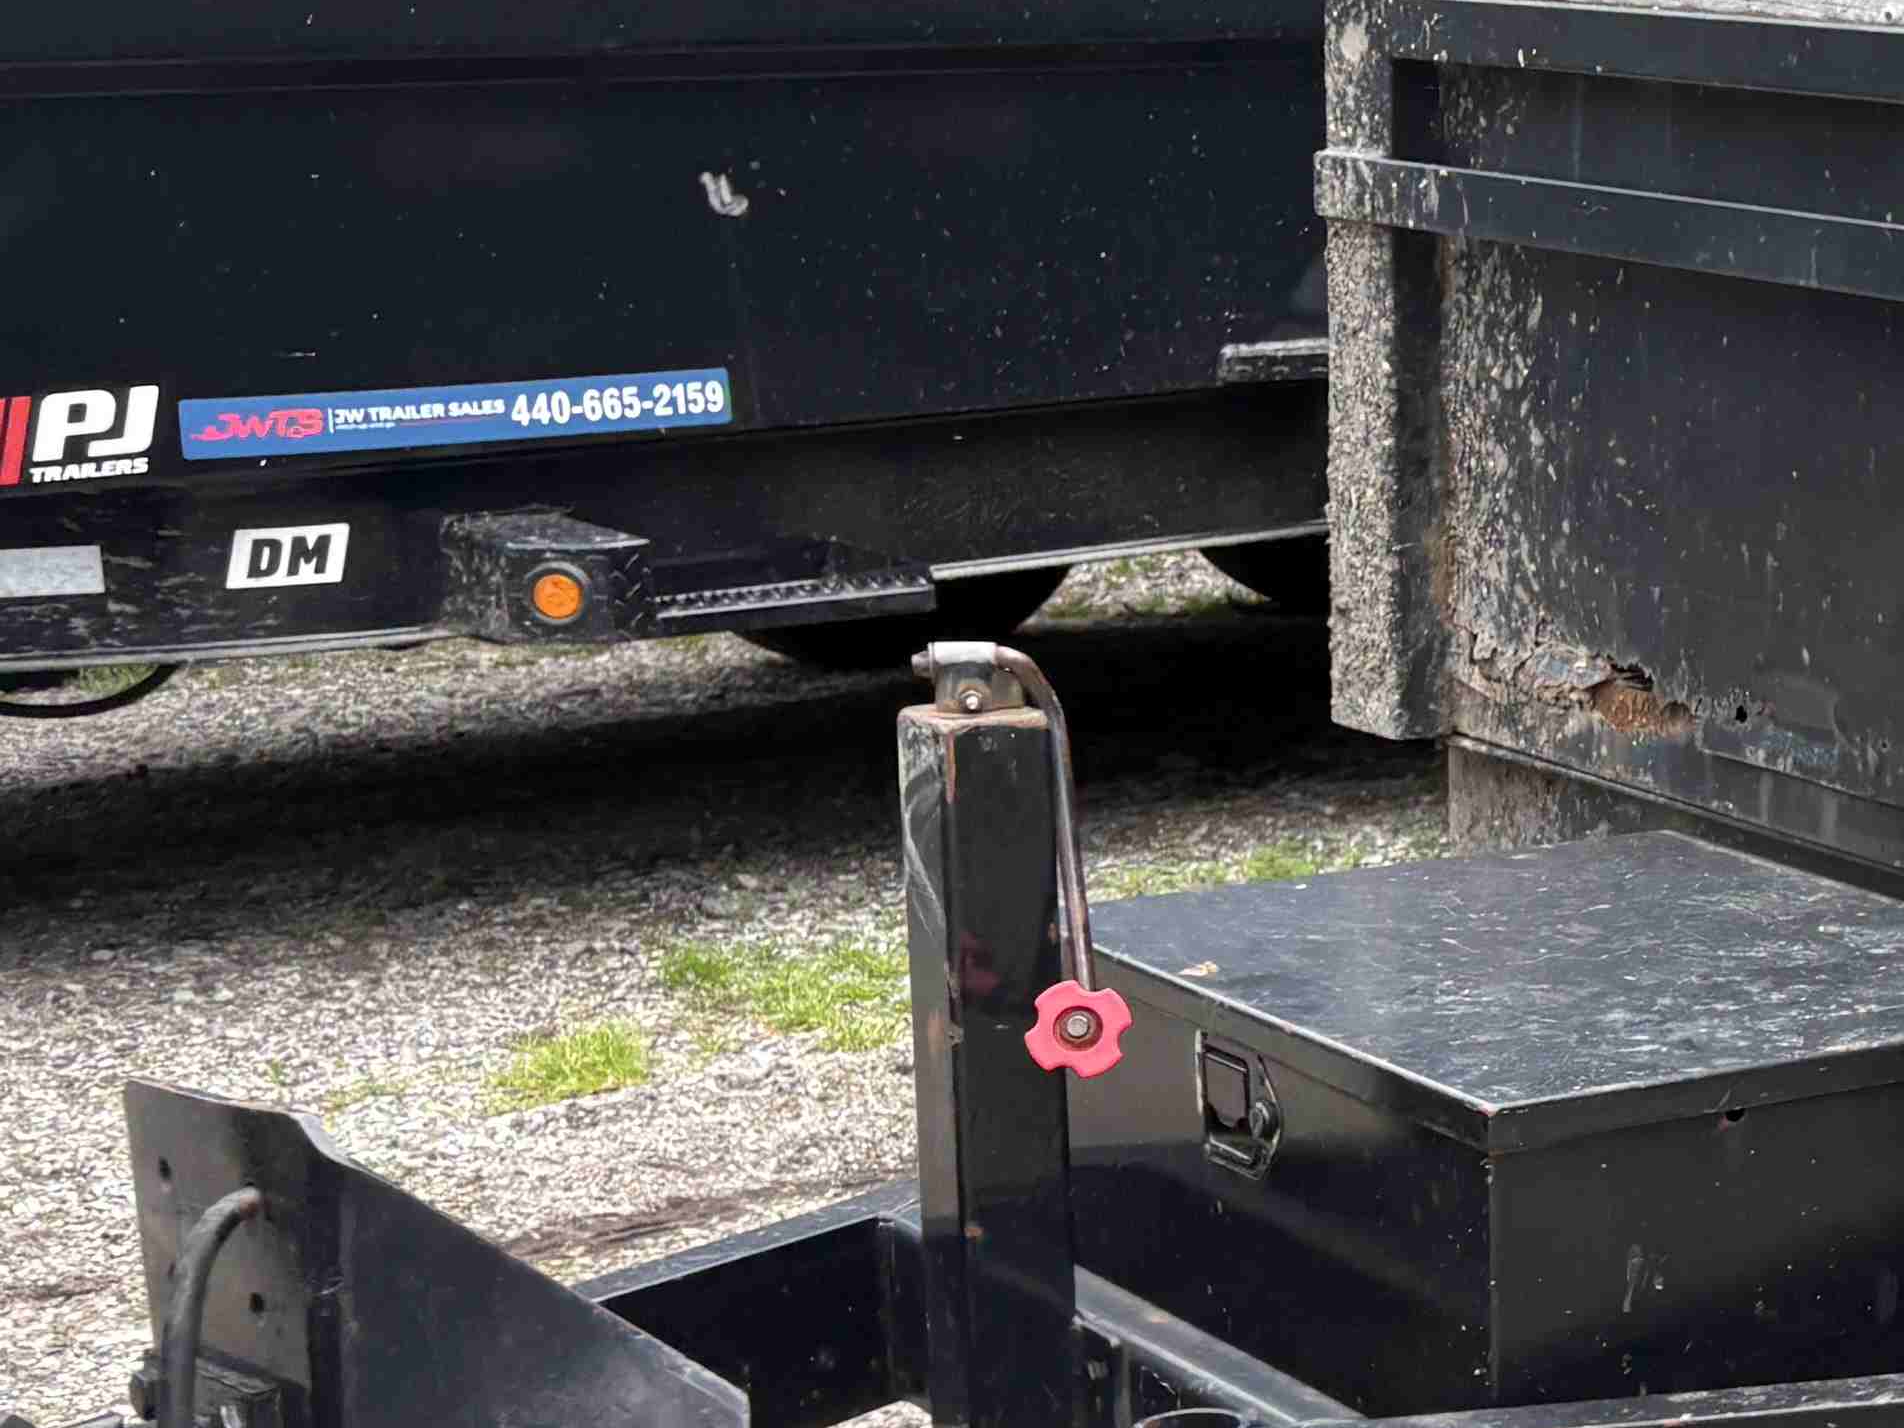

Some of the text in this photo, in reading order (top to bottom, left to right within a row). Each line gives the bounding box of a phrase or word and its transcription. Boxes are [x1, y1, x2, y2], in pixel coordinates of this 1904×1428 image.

[32, 385, 159, 462] PJ
[367, 403, 445, 421] TRAILER
[447, 398, 505, 417] SALES
[511, 380, 724, 426] 440-665-2159
[29, 457, 149, 483] TRAILERS
[246, 534, 332, 579] DM
